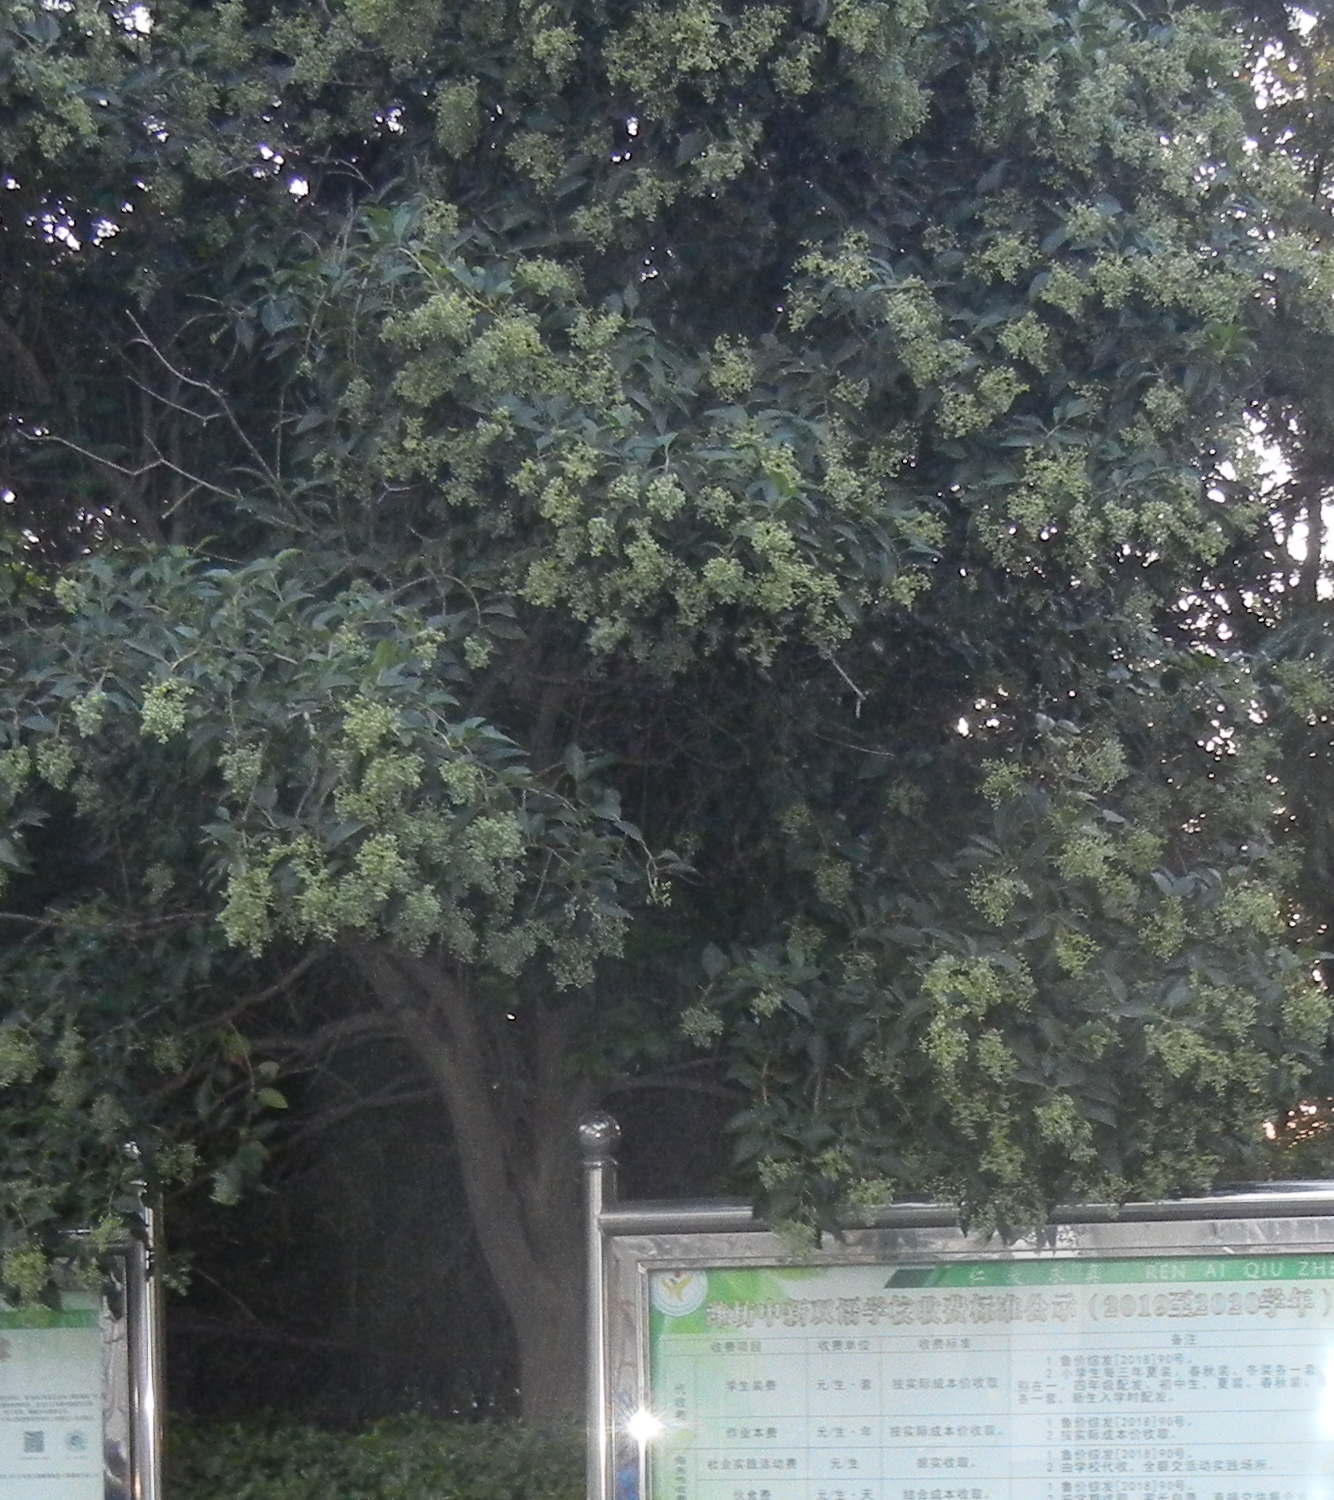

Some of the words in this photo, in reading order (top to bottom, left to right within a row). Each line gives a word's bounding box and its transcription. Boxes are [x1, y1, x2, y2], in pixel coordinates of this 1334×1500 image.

[1145, 1264, 1186, 1280] REN
[1205, 1262, 1225, 1277] AI
[1243, 1261, 1284, 1279] QIU
